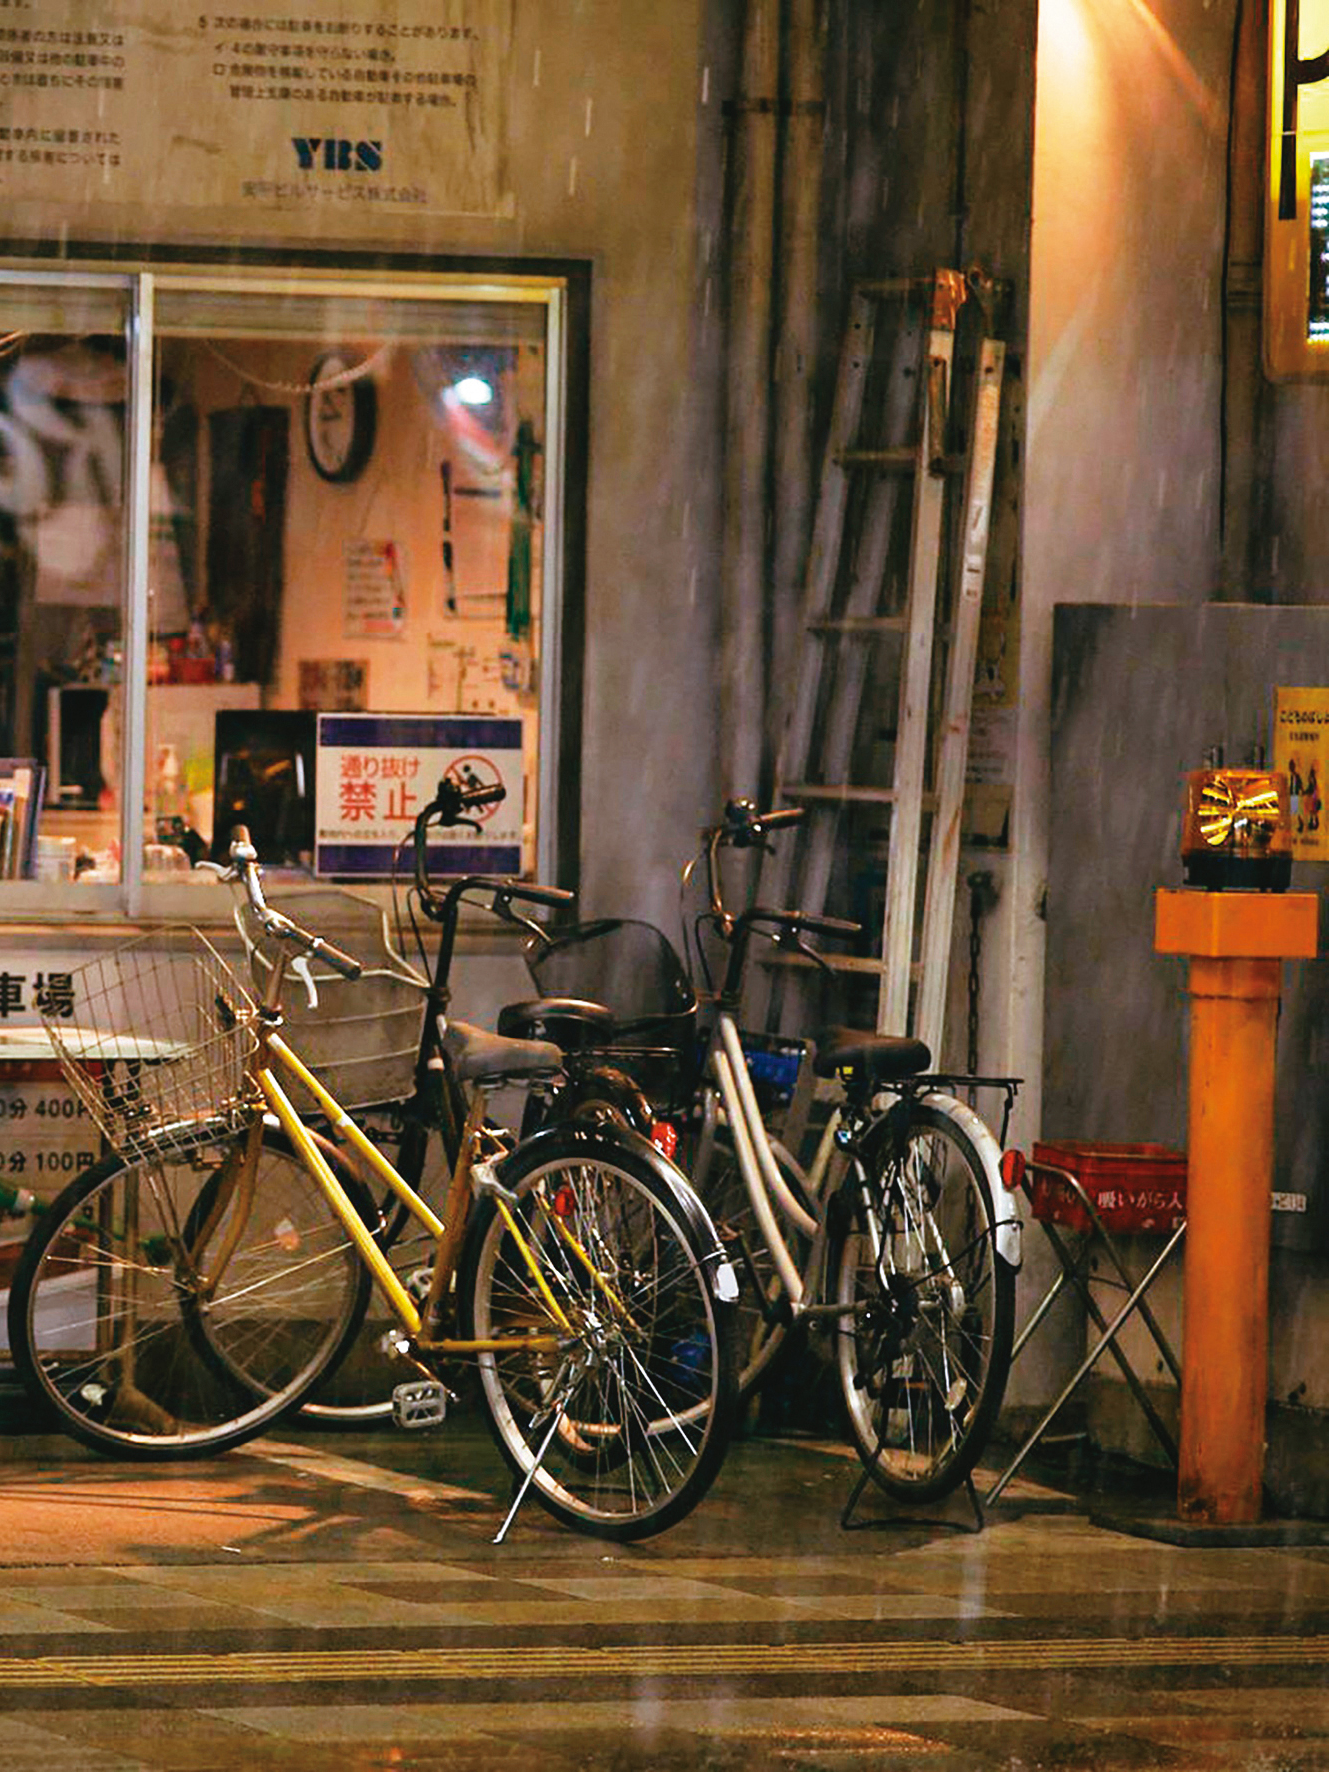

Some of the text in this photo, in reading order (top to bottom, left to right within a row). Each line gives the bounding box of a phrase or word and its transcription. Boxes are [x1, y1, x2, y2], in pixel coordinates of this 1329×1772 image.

[291, 137, 383, 172] YBS
[340, 754, 421, 779] 通り抜け
[339, 780, 419, 822] 禁止
[36, 1150, 95, 1172] 100円
